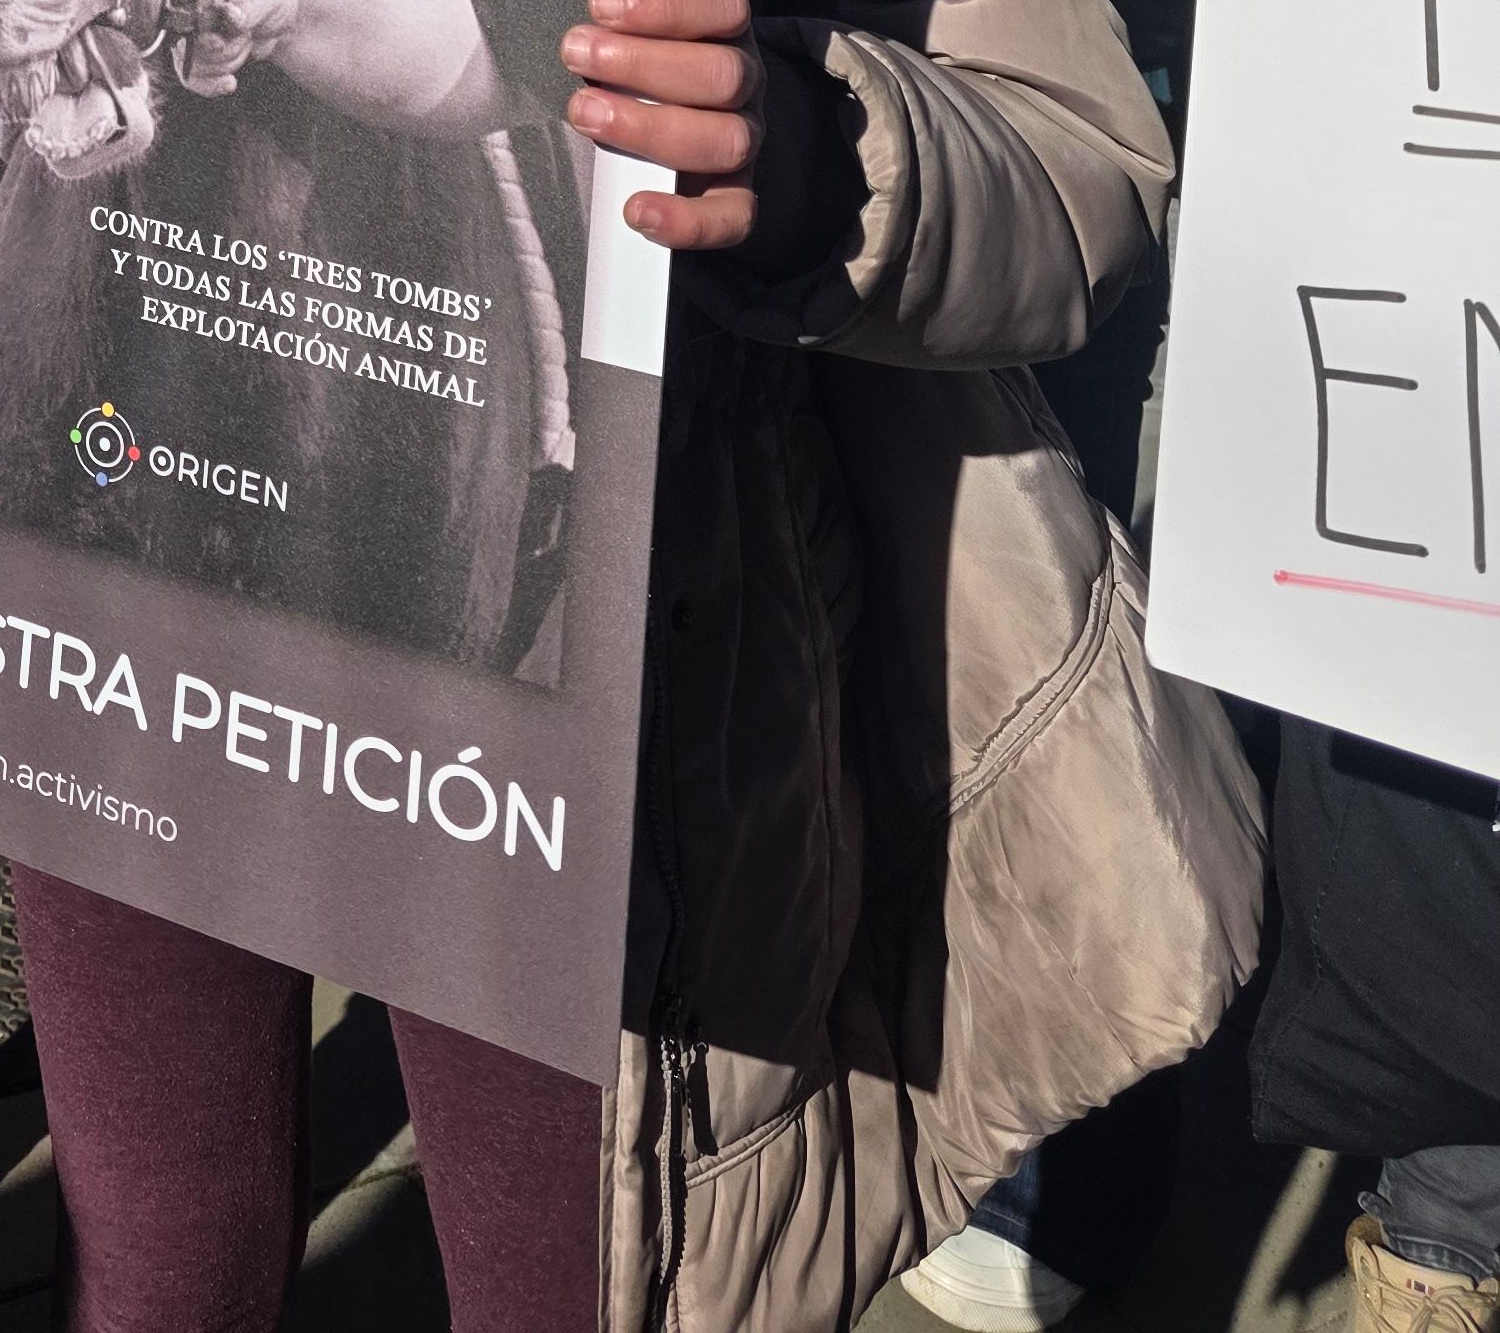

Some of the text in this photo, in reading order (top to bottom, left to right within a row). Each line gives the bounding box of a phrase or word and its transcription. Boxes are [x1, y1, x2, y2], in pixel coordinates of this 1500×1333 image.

[90, 205, 204, 257] CONTRA
[211, 234, 268, 271] LOS
[110, 248, 489, 366] Y TODAS LAS FORMAS DE
[140, 295, 487, 409] EXPLOTACIÓN ANIMAL
[149, 445, 288, 512] ORIGEN
[171, 672, 567, 873] PETICIÓN
